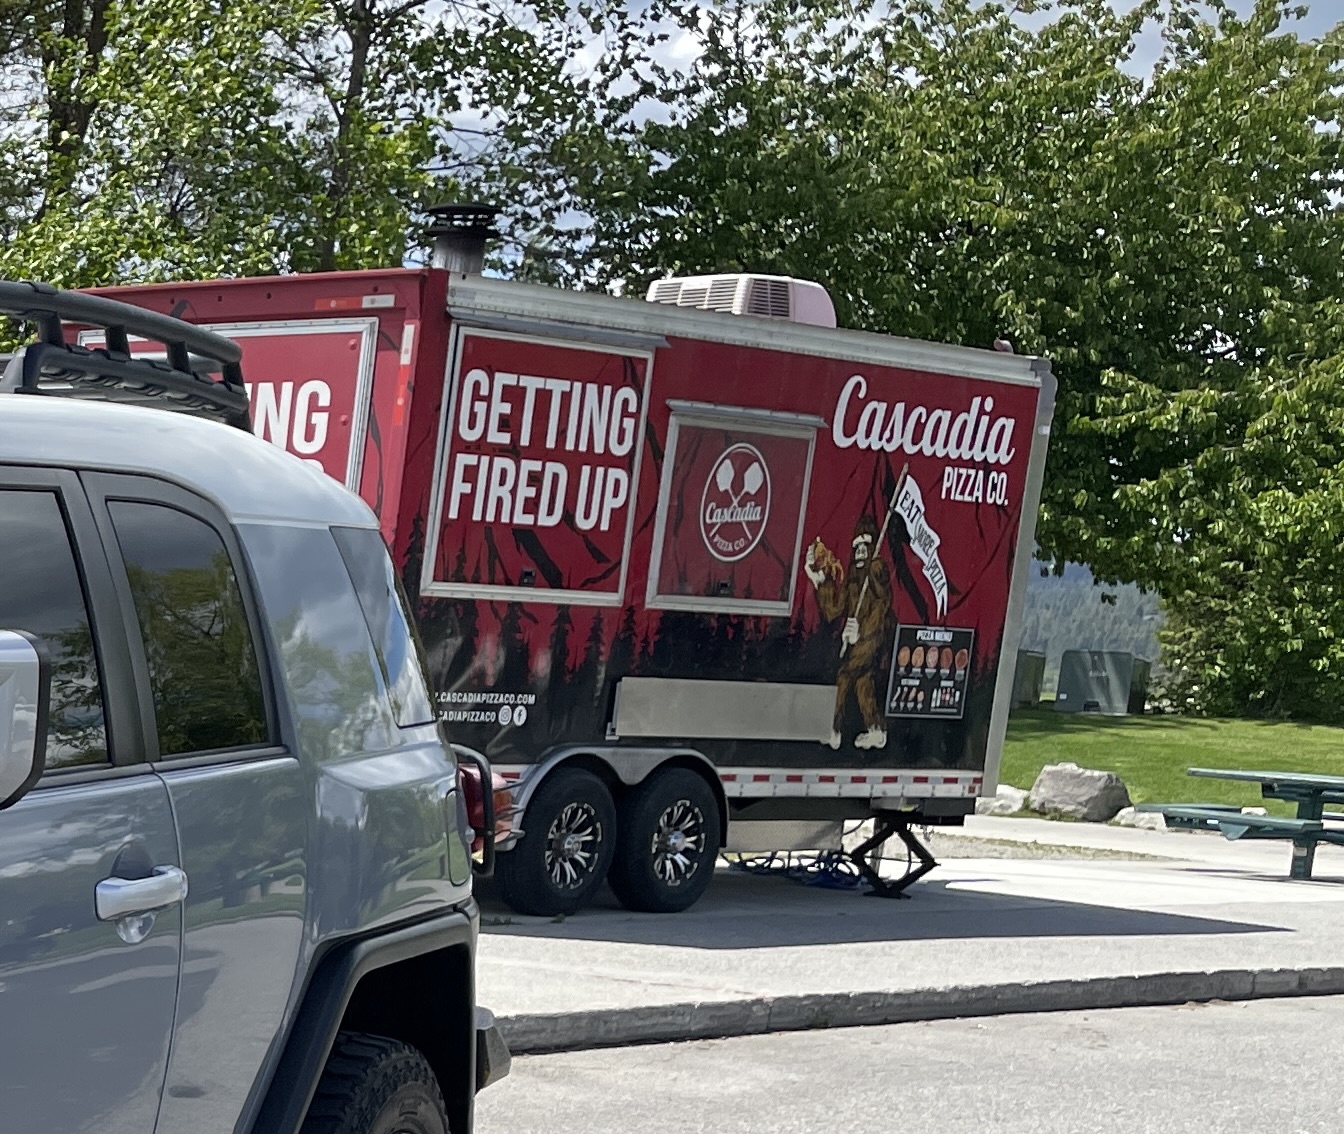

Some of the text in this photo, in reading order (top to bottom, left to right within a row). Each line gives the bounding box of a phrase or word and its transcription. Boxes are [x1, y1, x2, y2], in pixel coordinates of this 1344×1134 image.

[458, 368, 638, 457] GETTING
[832, 374, 1015, 465] Cascadia
[448, 453, 629, 532] FIRED UP
[705, 501, 762, 524] Cascadia
[899, 490, 922, 524] EAT
[941, 466, 1009, 506] PIZZA CO.
